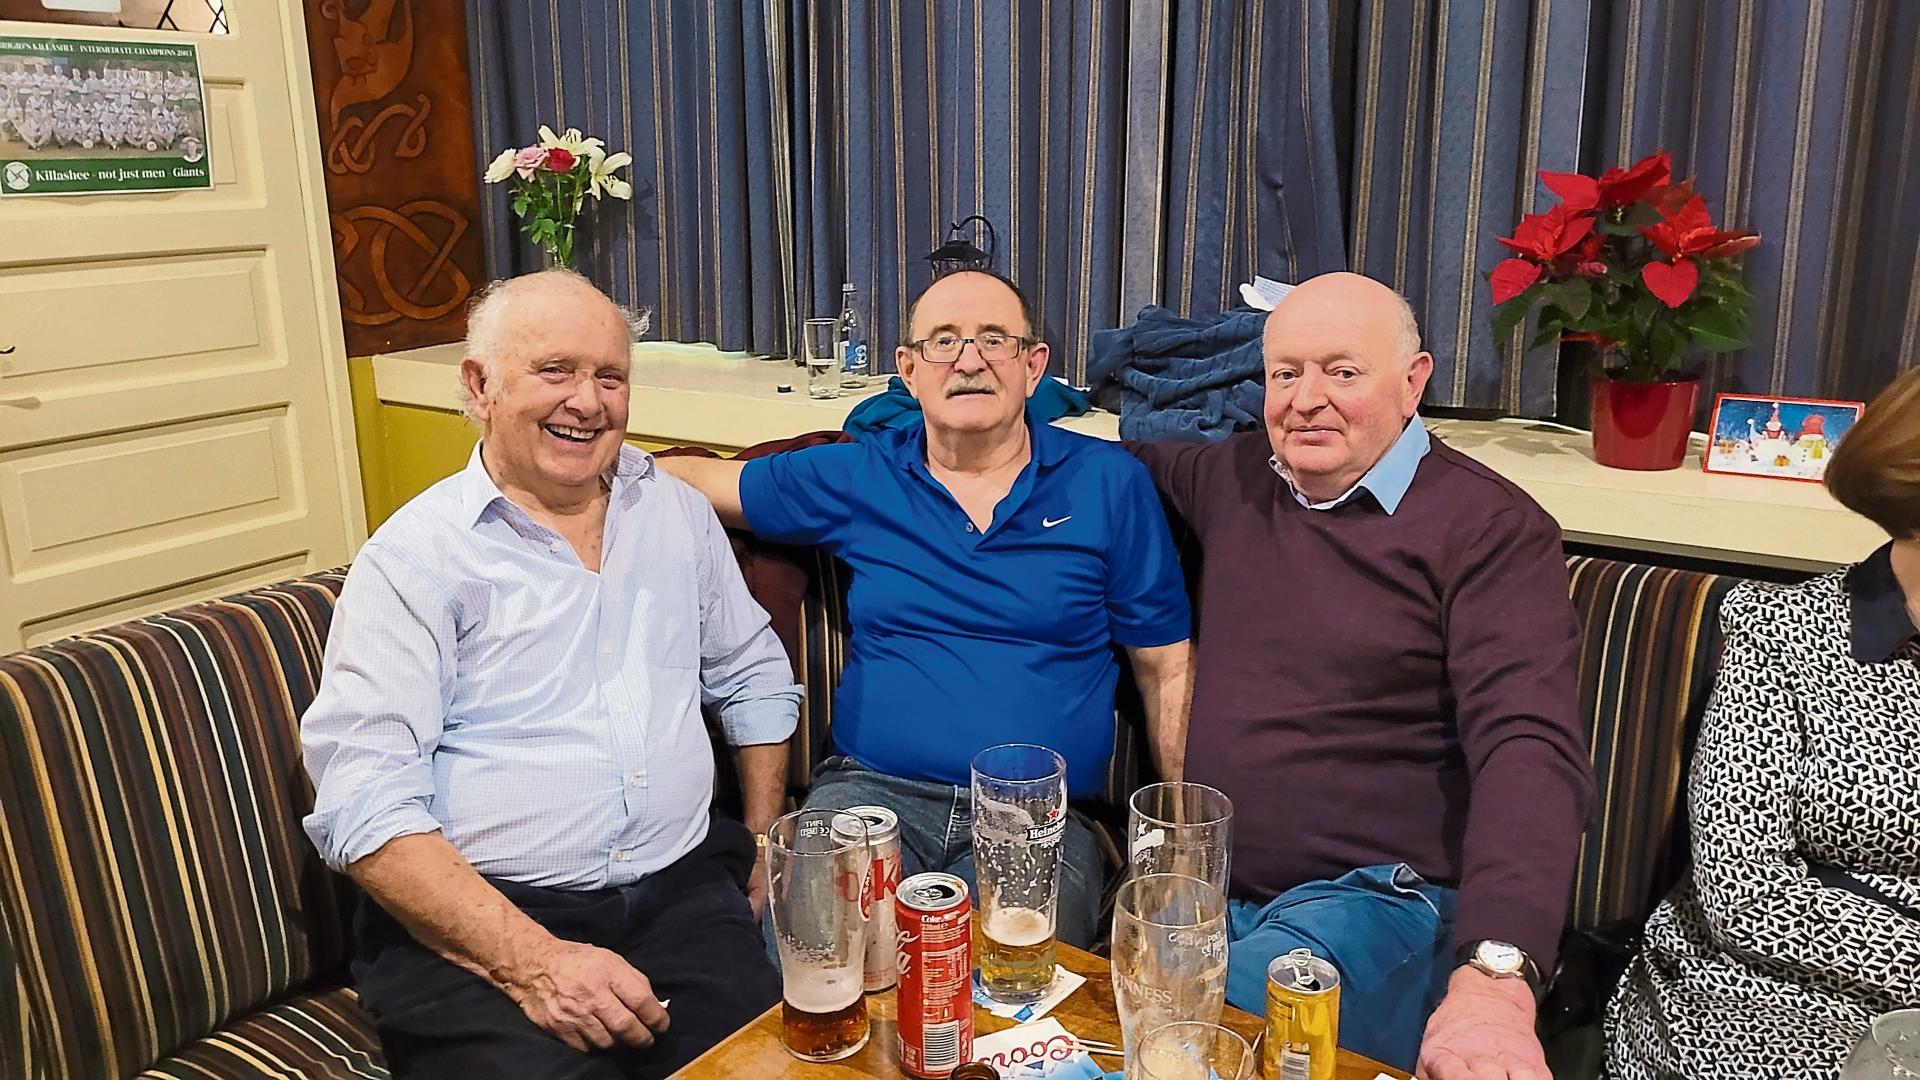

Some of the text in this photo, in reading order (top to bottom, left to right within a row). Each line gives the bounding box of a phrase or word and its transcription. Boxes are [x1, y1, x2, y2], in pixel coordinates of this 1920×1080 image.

[80, 45, 131, 54] INTERMEDIATE
[134, 48, 175, 56] CHAMPIONS
[35, 170, 90, 181] Killashee
[98, 170, 117, 180] not
[118, 168, 139, 182] just
[142, 169, 166, 178] men
[172, 167, 205, 177] Giants
[1114, 974, 1173, 1004] INNESS
